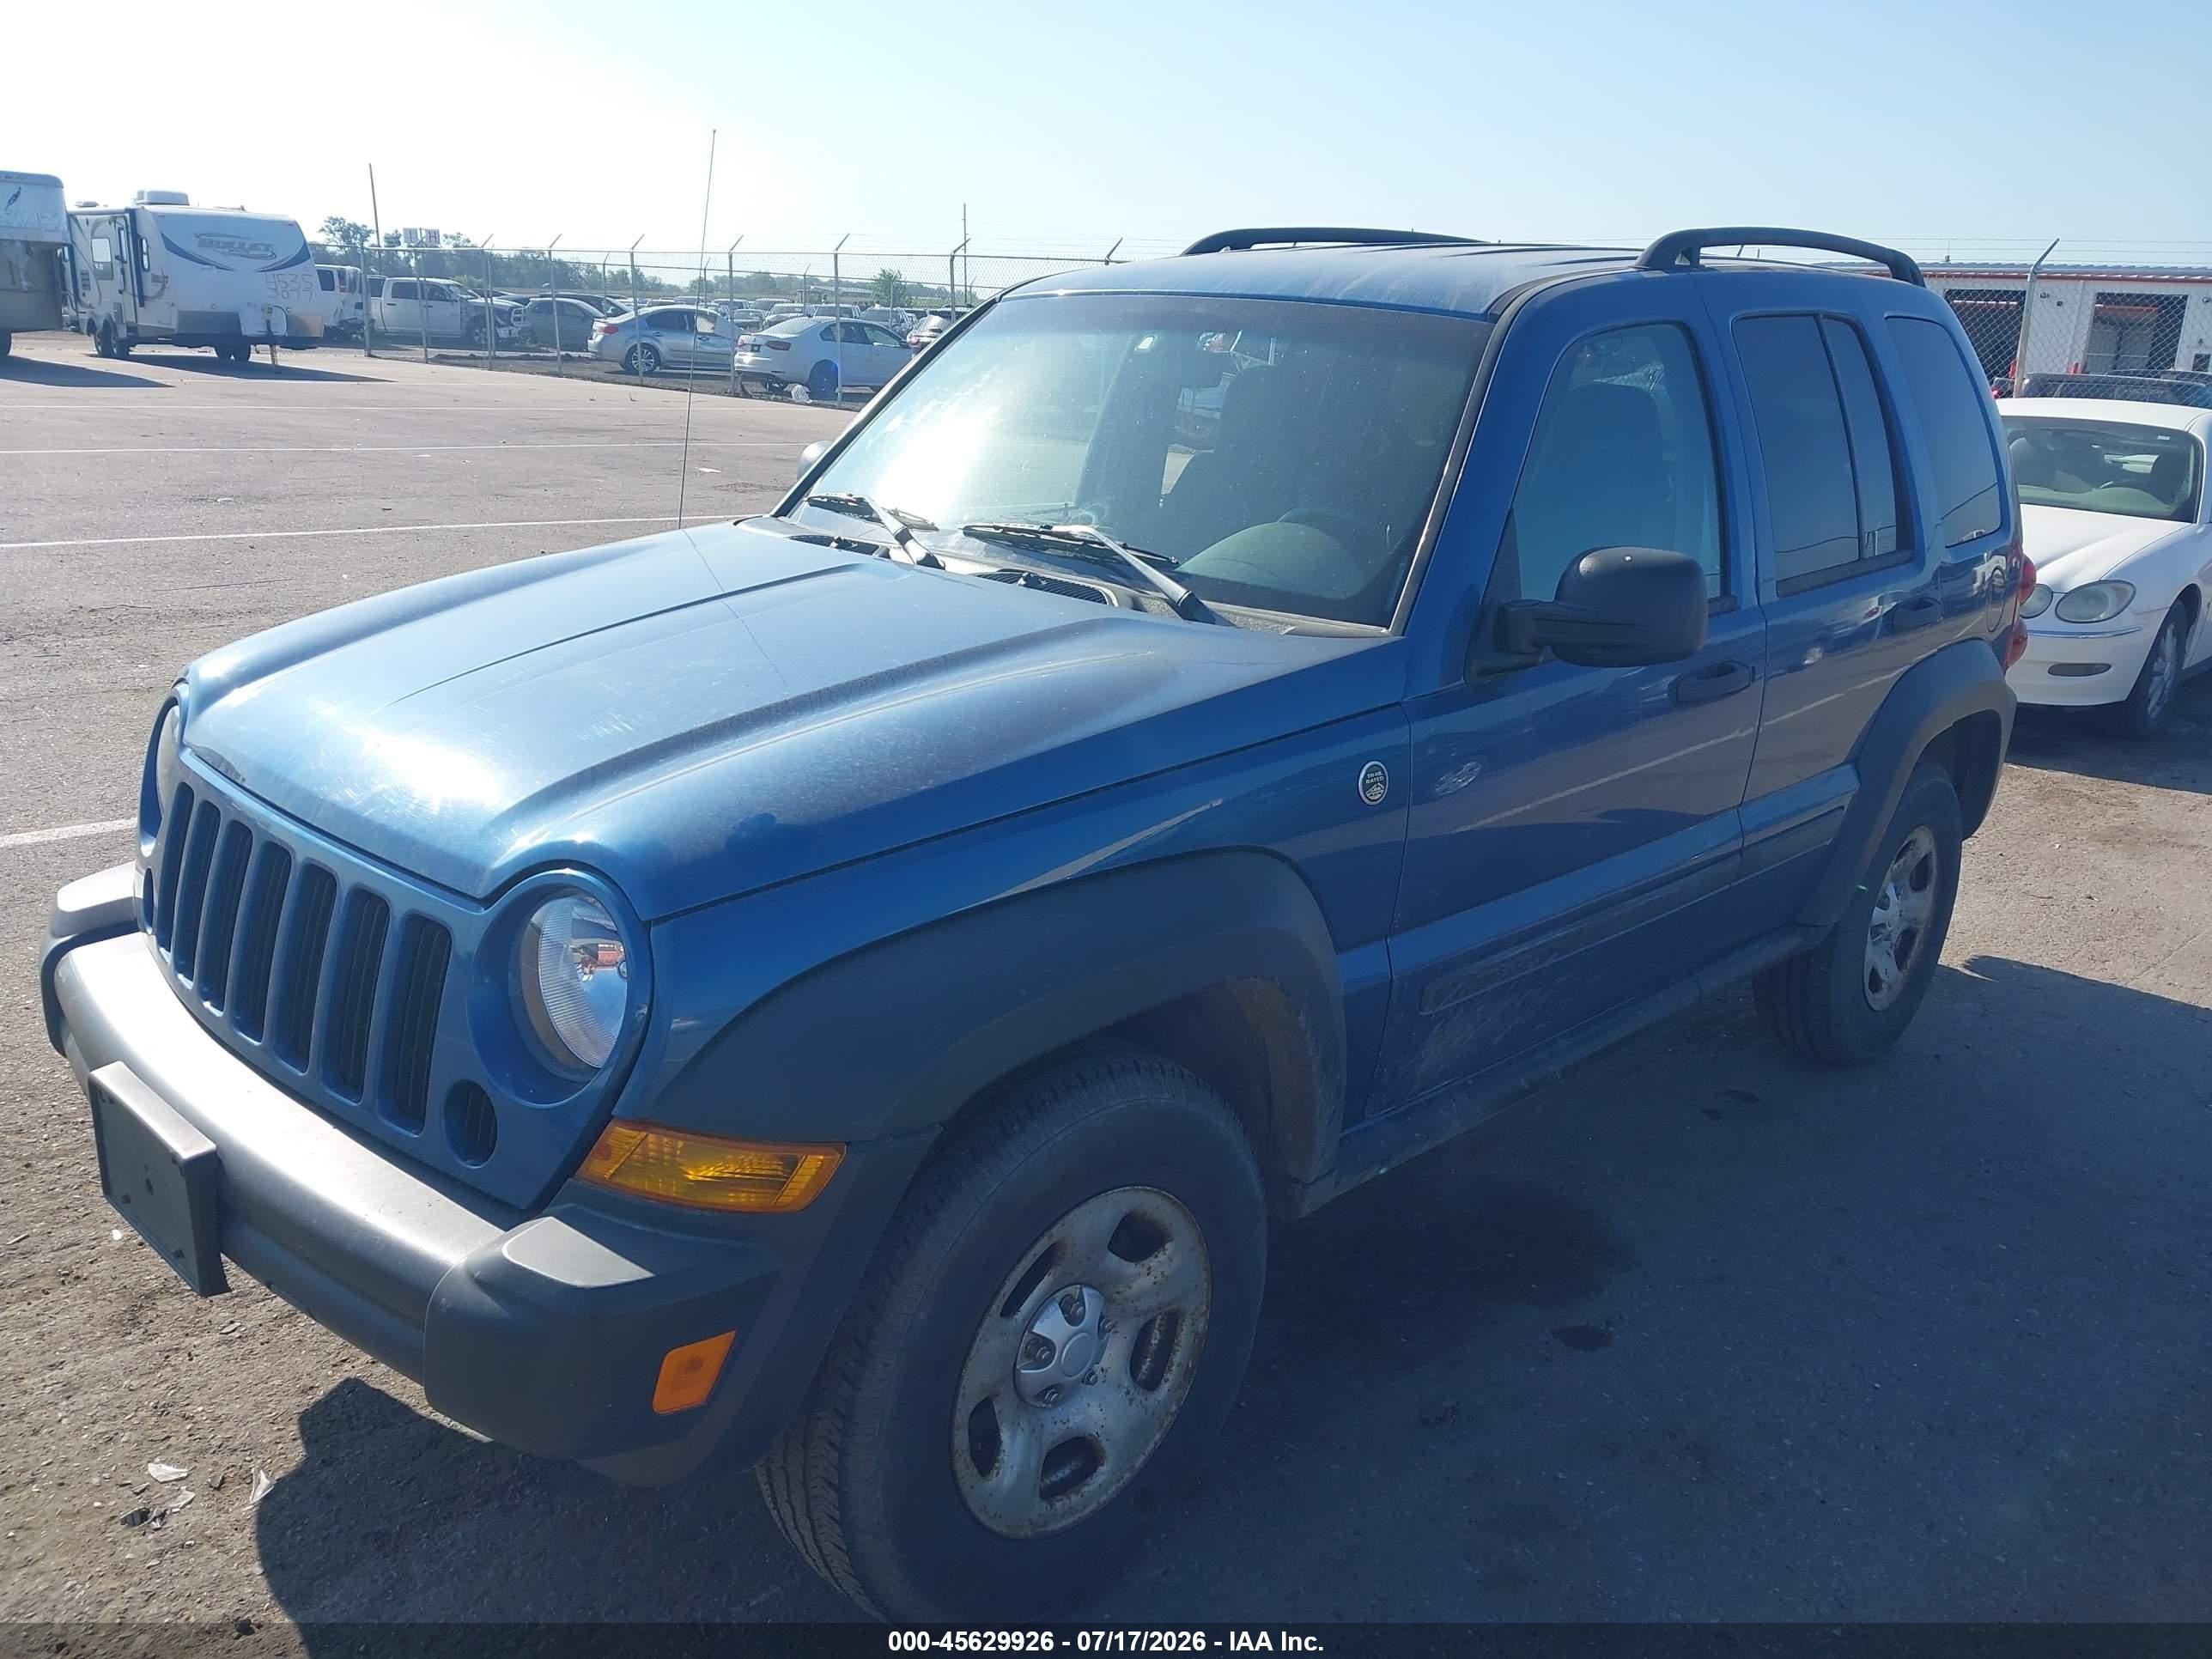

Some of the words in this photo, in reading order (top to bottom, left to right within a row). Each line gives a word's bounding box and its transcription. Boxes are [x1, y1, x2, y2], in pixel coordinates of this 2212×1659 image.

[264, 272, 313, 289] 4535
[267, 288, 313, 301] 3077
[1365, 775, 1384, 784] RATED
